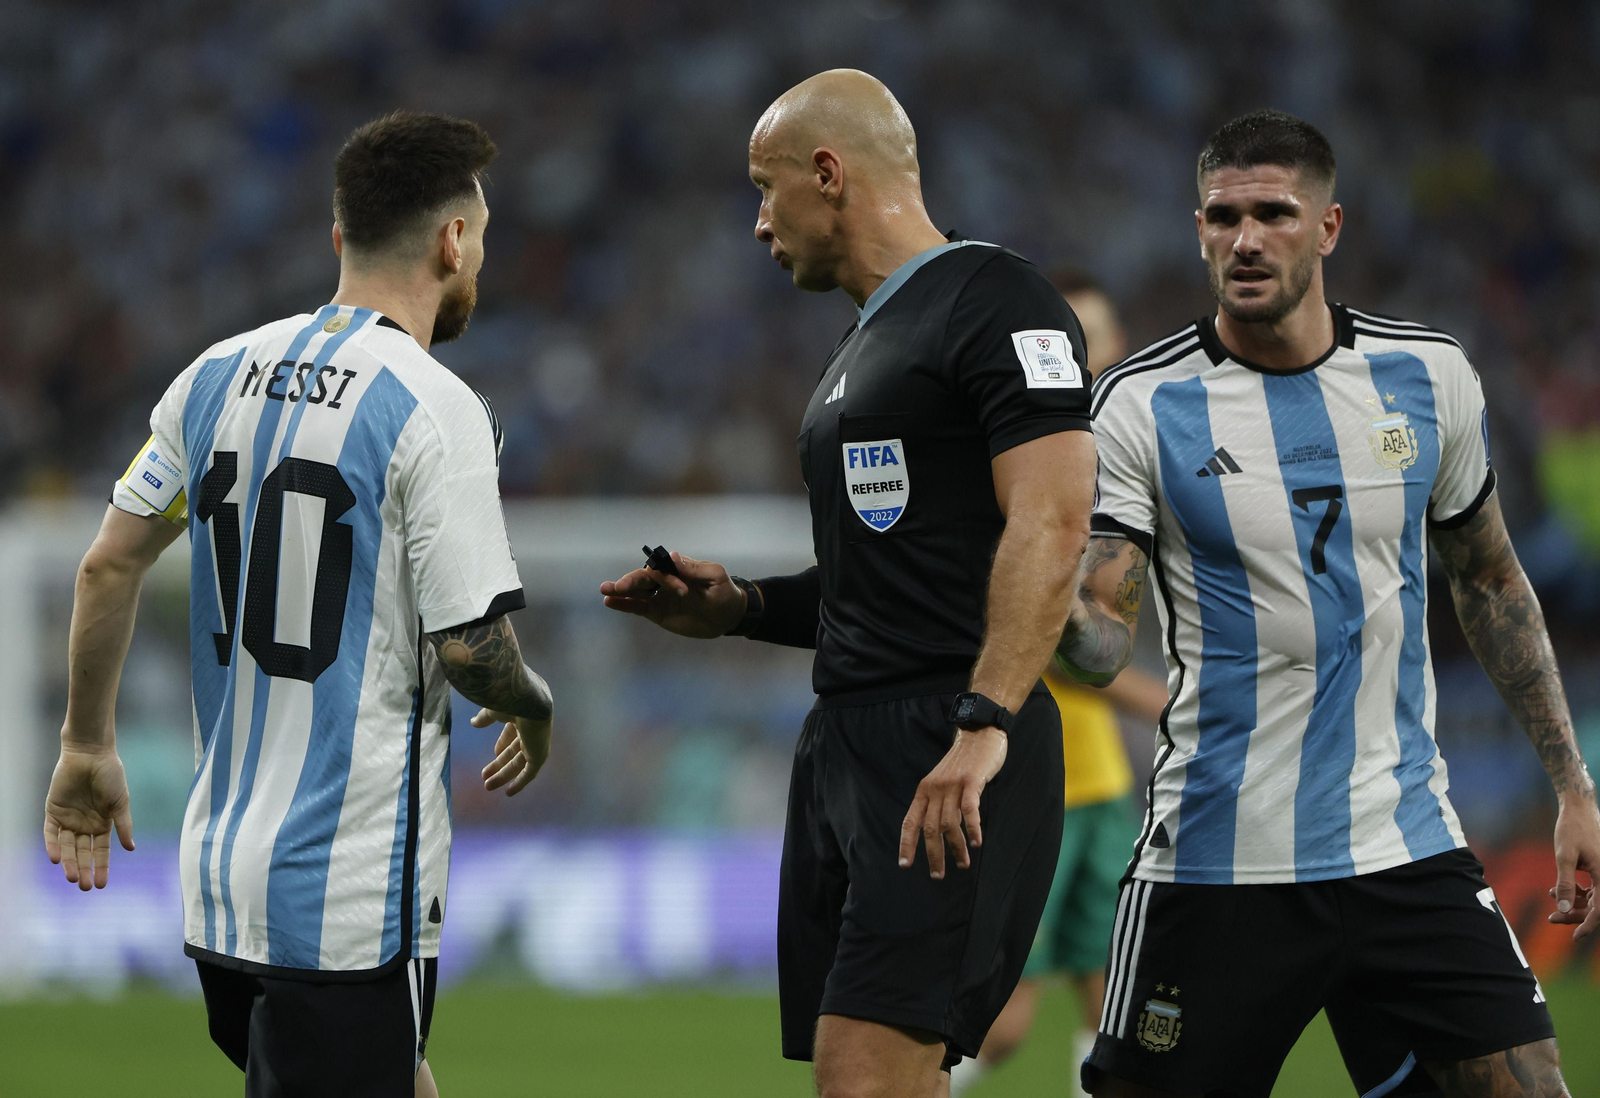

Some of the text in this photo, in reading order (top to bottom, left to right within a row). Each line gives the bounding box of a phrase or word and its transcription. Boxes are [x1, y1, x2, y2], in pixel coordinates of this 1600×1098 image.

[1039, 358, 1061, 366] UNITES
[239, 360, 358, 409] MESSI
[1293, 444, 1321, 452] AUSTRALIA
[1383, 429, 1407, 454] AFA
[847, 445, 899, 469] FIFA
[1291, 451, 1318, 459] DECEMBER
[157, 459, 179, 478] unesco
[144, 473, 159, 487] FIFA
[851, 480, 904, 495] REFEREE
[869, 511, 893, 522] 2022
[1291, 485, 1343, 575] 7
[196, 451, 357, 684] 10
[1146, 1013, 1170, 1039] AFA
